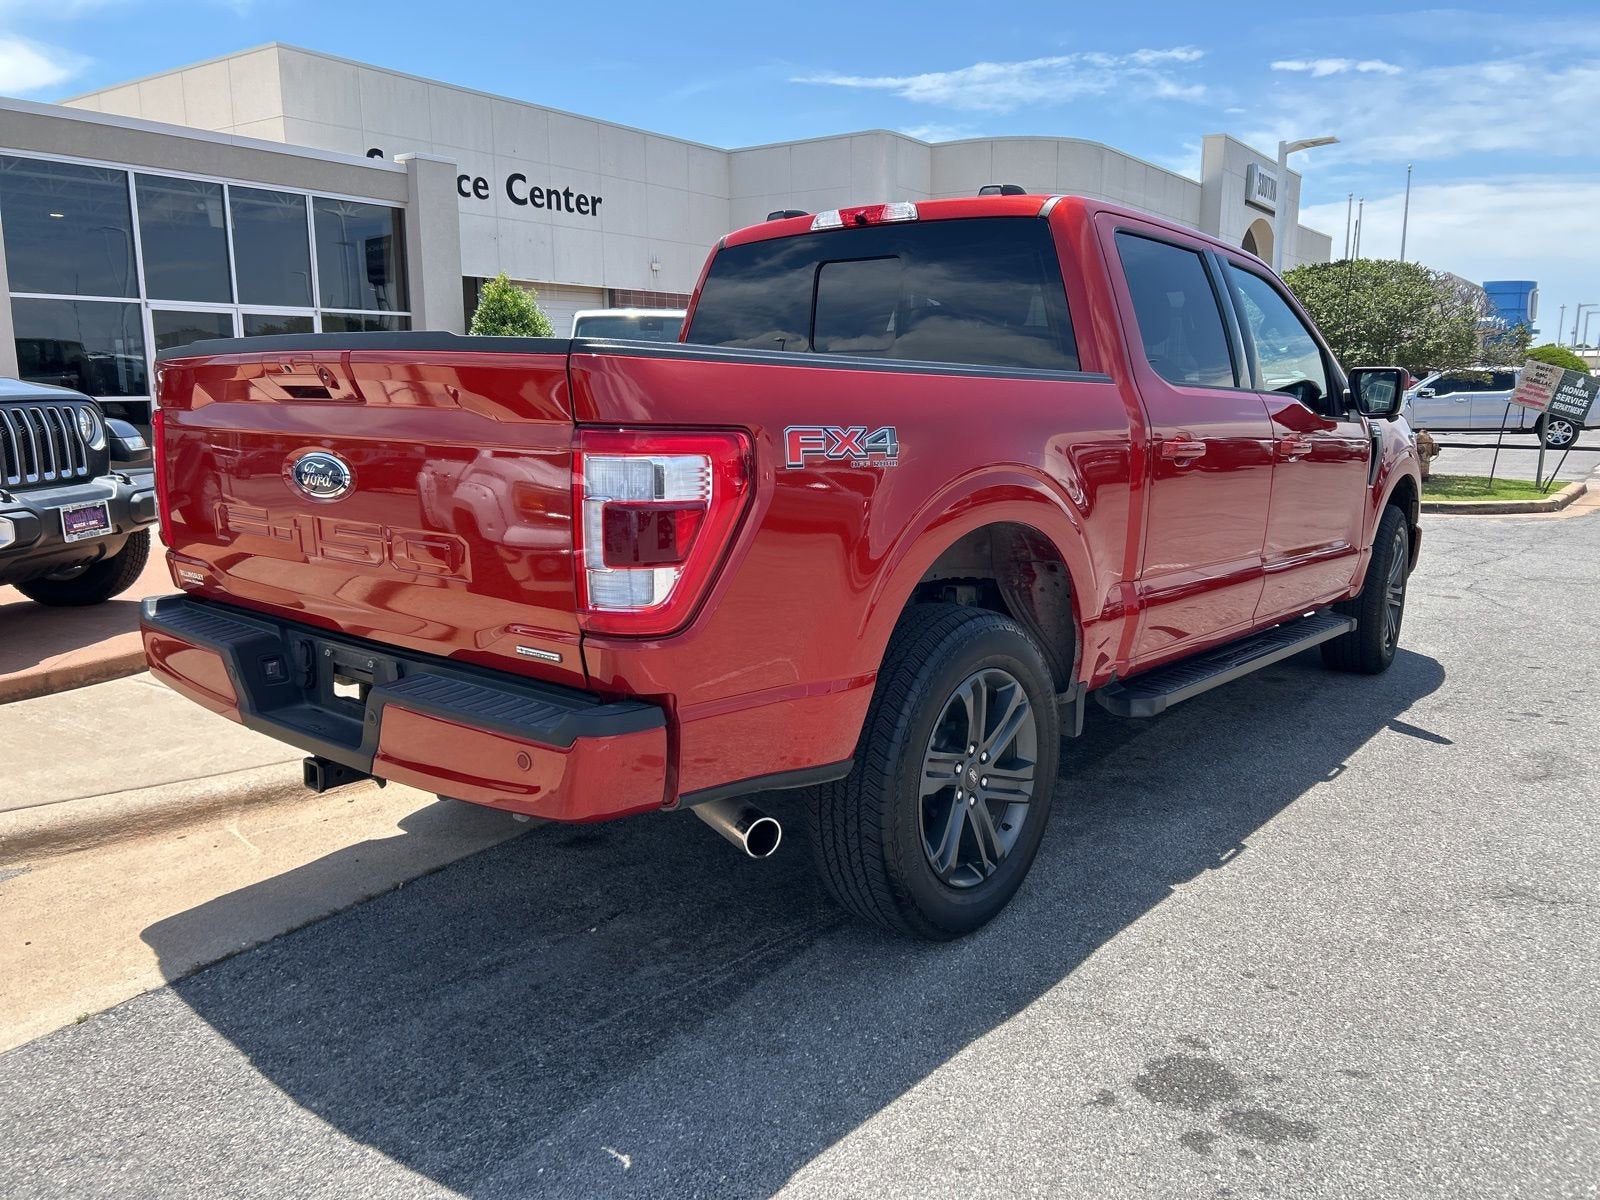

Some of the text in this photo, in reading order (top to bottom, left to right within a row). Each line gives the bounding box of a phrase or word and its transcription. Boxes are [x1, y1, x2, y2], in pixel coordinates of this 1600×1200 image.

[506, 172, 602, 216] Center
[1526, 376, 1553, 387] CADILLAC
[1562, 384, 1589, 398] HONDA
[1555, 393, 1589, 407] SERVICE
[1552, 401, 1584, 415] DEPARTMENT
[784, 425, 899, 469] FX4
[851, 460, 870, 468] OFF
[302, 461, 332, 487] Ford
[213, 502, 472, 584] F-150
